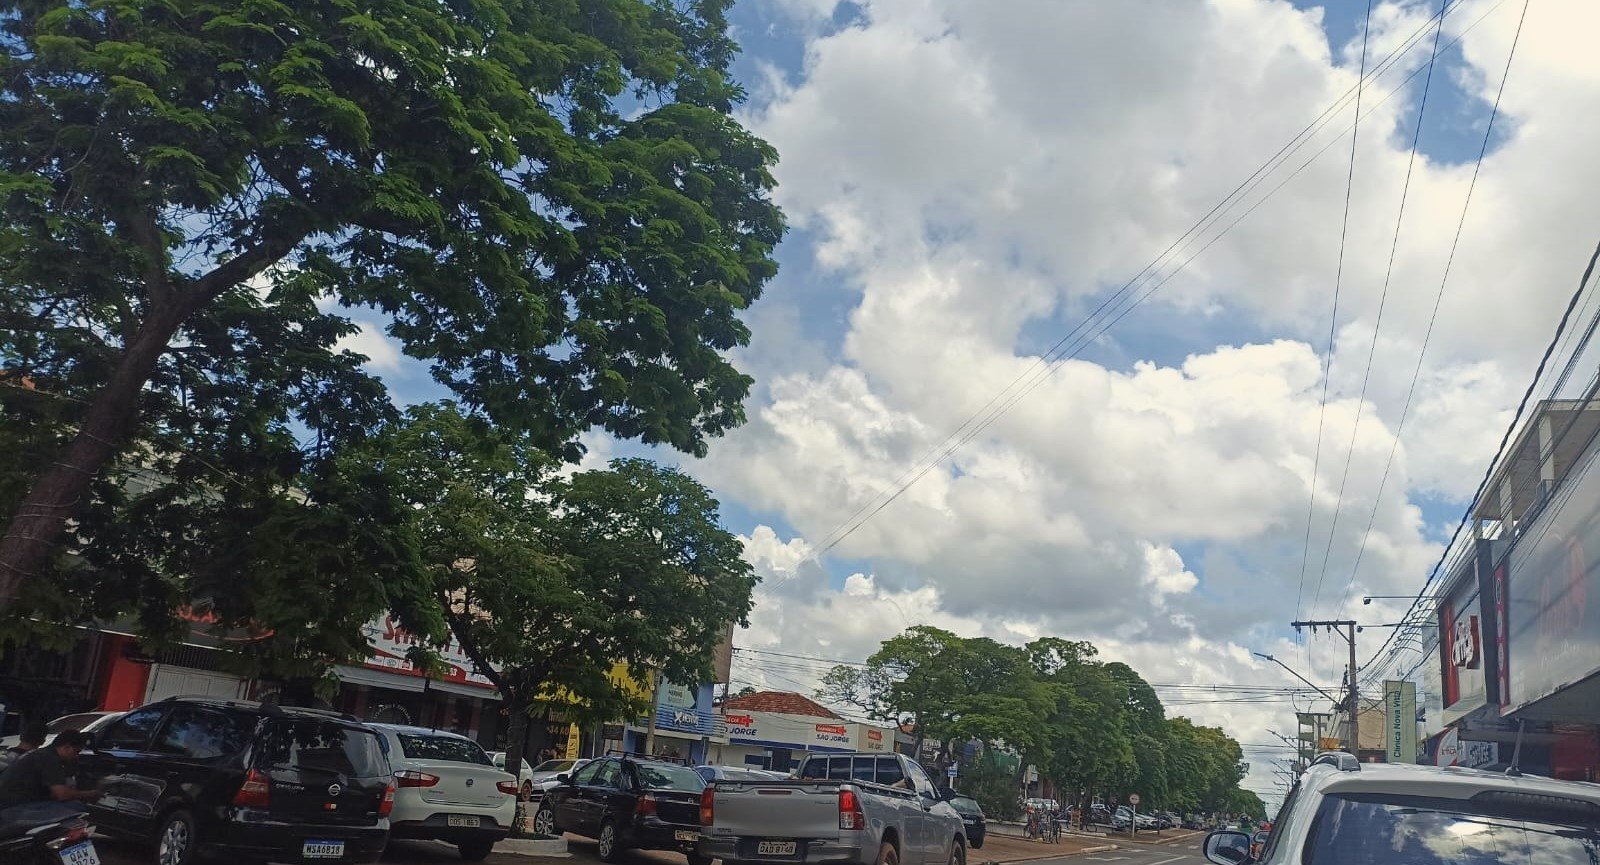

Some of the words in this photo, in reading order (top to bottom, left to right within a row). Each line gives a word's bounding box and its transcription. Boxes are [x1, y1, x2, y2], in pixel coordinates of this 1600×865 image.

[1393, 709, 1401, 730] Nova
[729, 727, 758, 736] JORGE
[830, 735, 850, 743] JORGE
